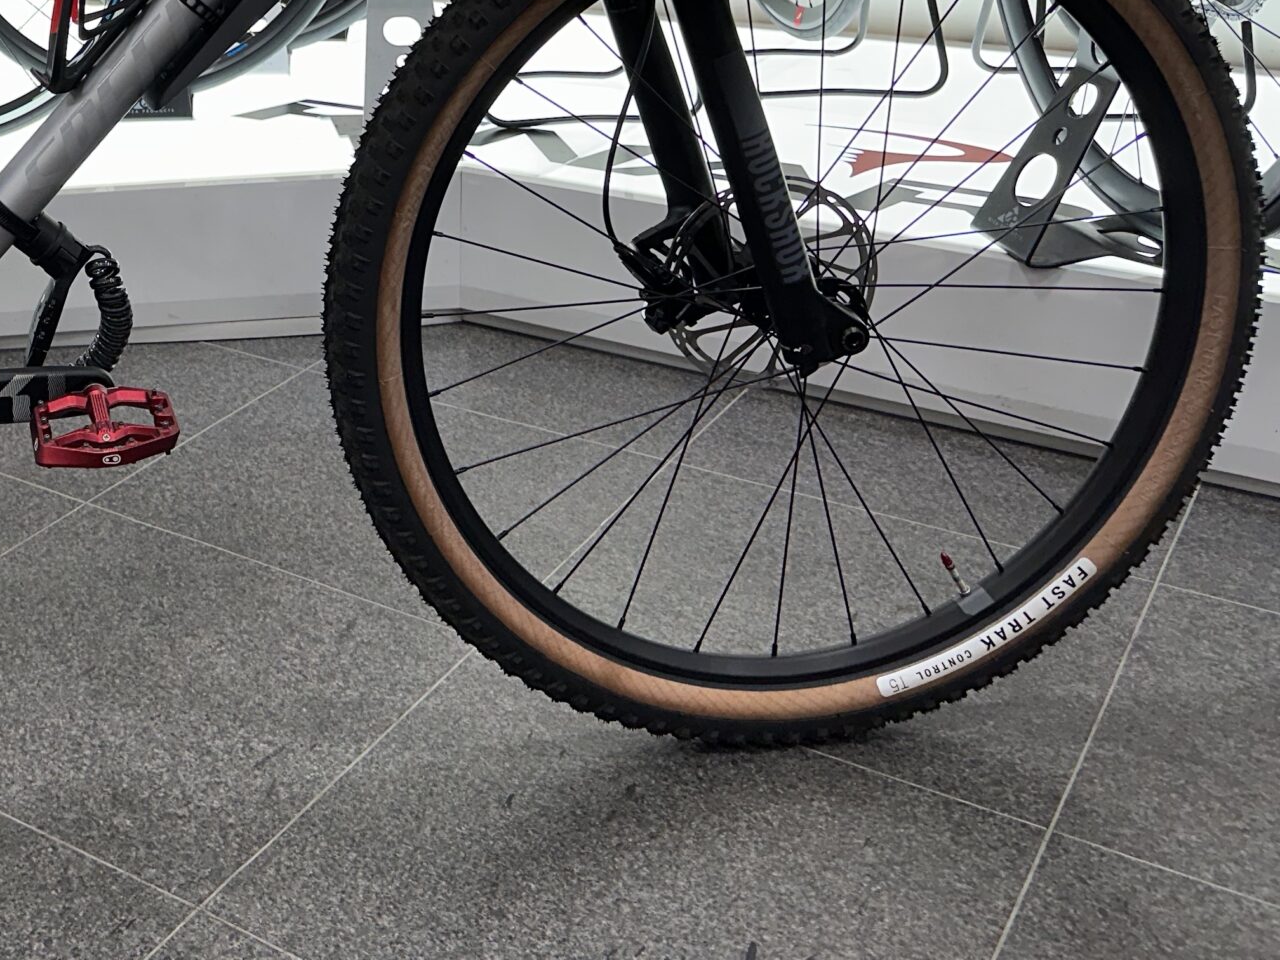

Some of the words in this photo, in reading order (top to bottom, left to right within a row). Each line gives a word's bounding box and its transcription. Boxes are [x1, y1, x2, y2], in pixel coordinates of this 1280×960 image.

[742, 130, 811, 285] ROCKSHOX
[1042, 566, 1089, 610] FAST
[980, 611, 1037, 651] TRAK
[888, 675, 909, 693] T5
[915, 649, 972, 680] CONTROL
